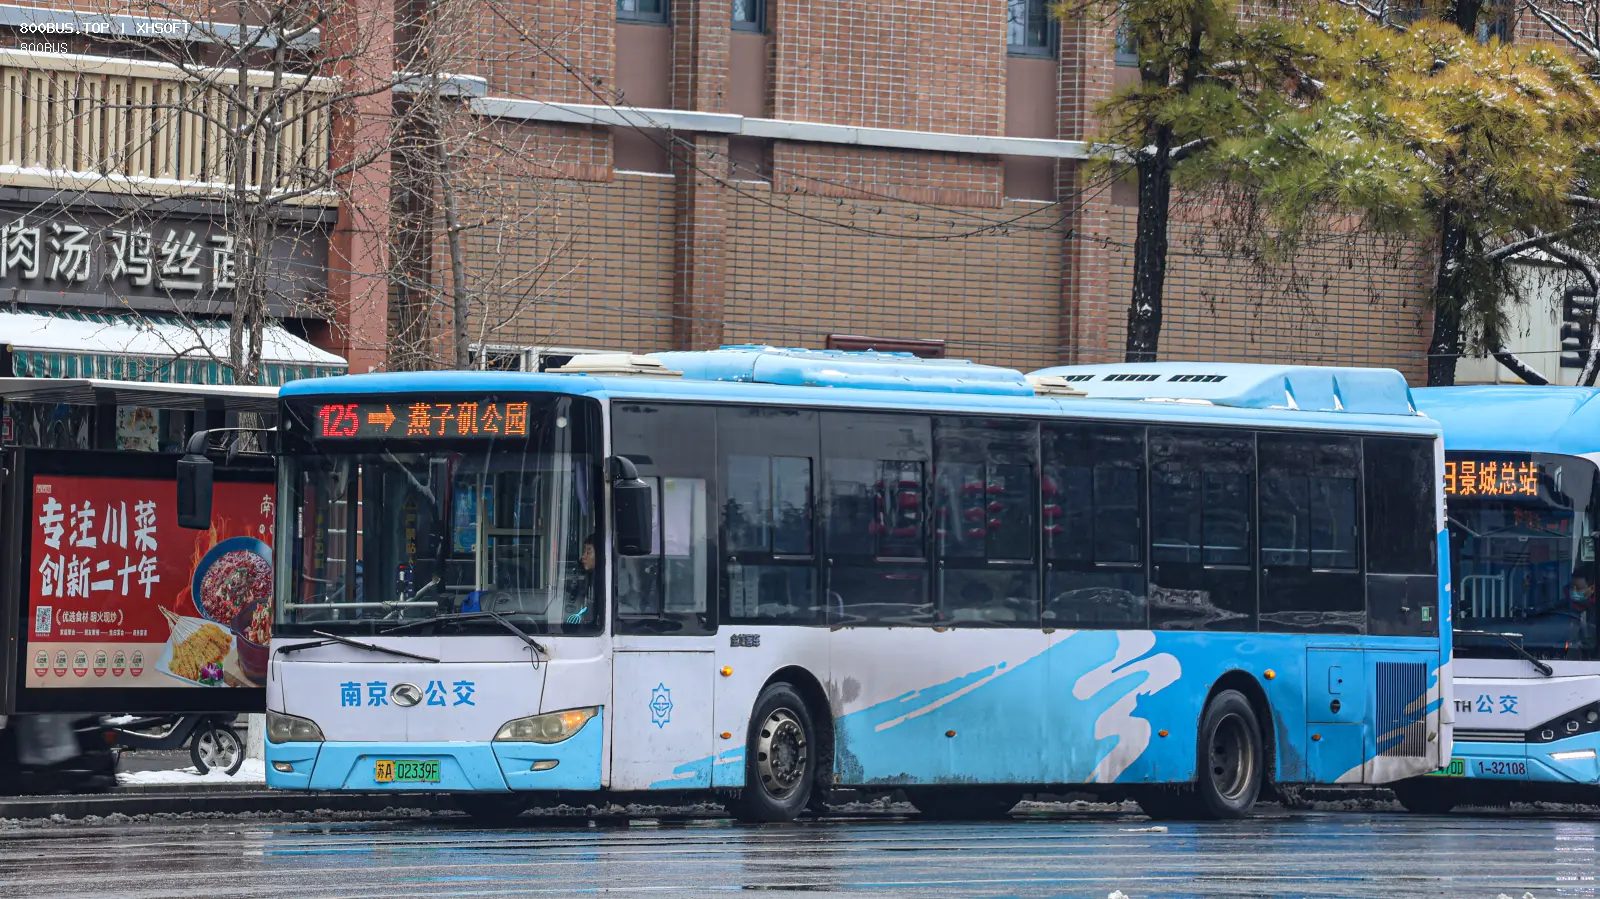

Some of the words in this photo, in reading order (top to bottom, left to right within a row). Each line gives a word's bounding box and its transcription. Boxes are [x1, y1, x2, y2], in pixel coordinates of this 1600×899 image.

[319, 404, 359, 436] 125
[407, 402, 528, 436] 燕子矶公园
[39, 496, 158, 551] 专注川菜
[39, 552, 160, 599] 创新二十年
[340, 681, 388, 707] 南京
[425, 680, 475, 707] 公交
[1476, 694, 1518, 714] 公交
[397, 763, 438, 779] 02339F
[1478, 761, 1525, 775] 1-32108
